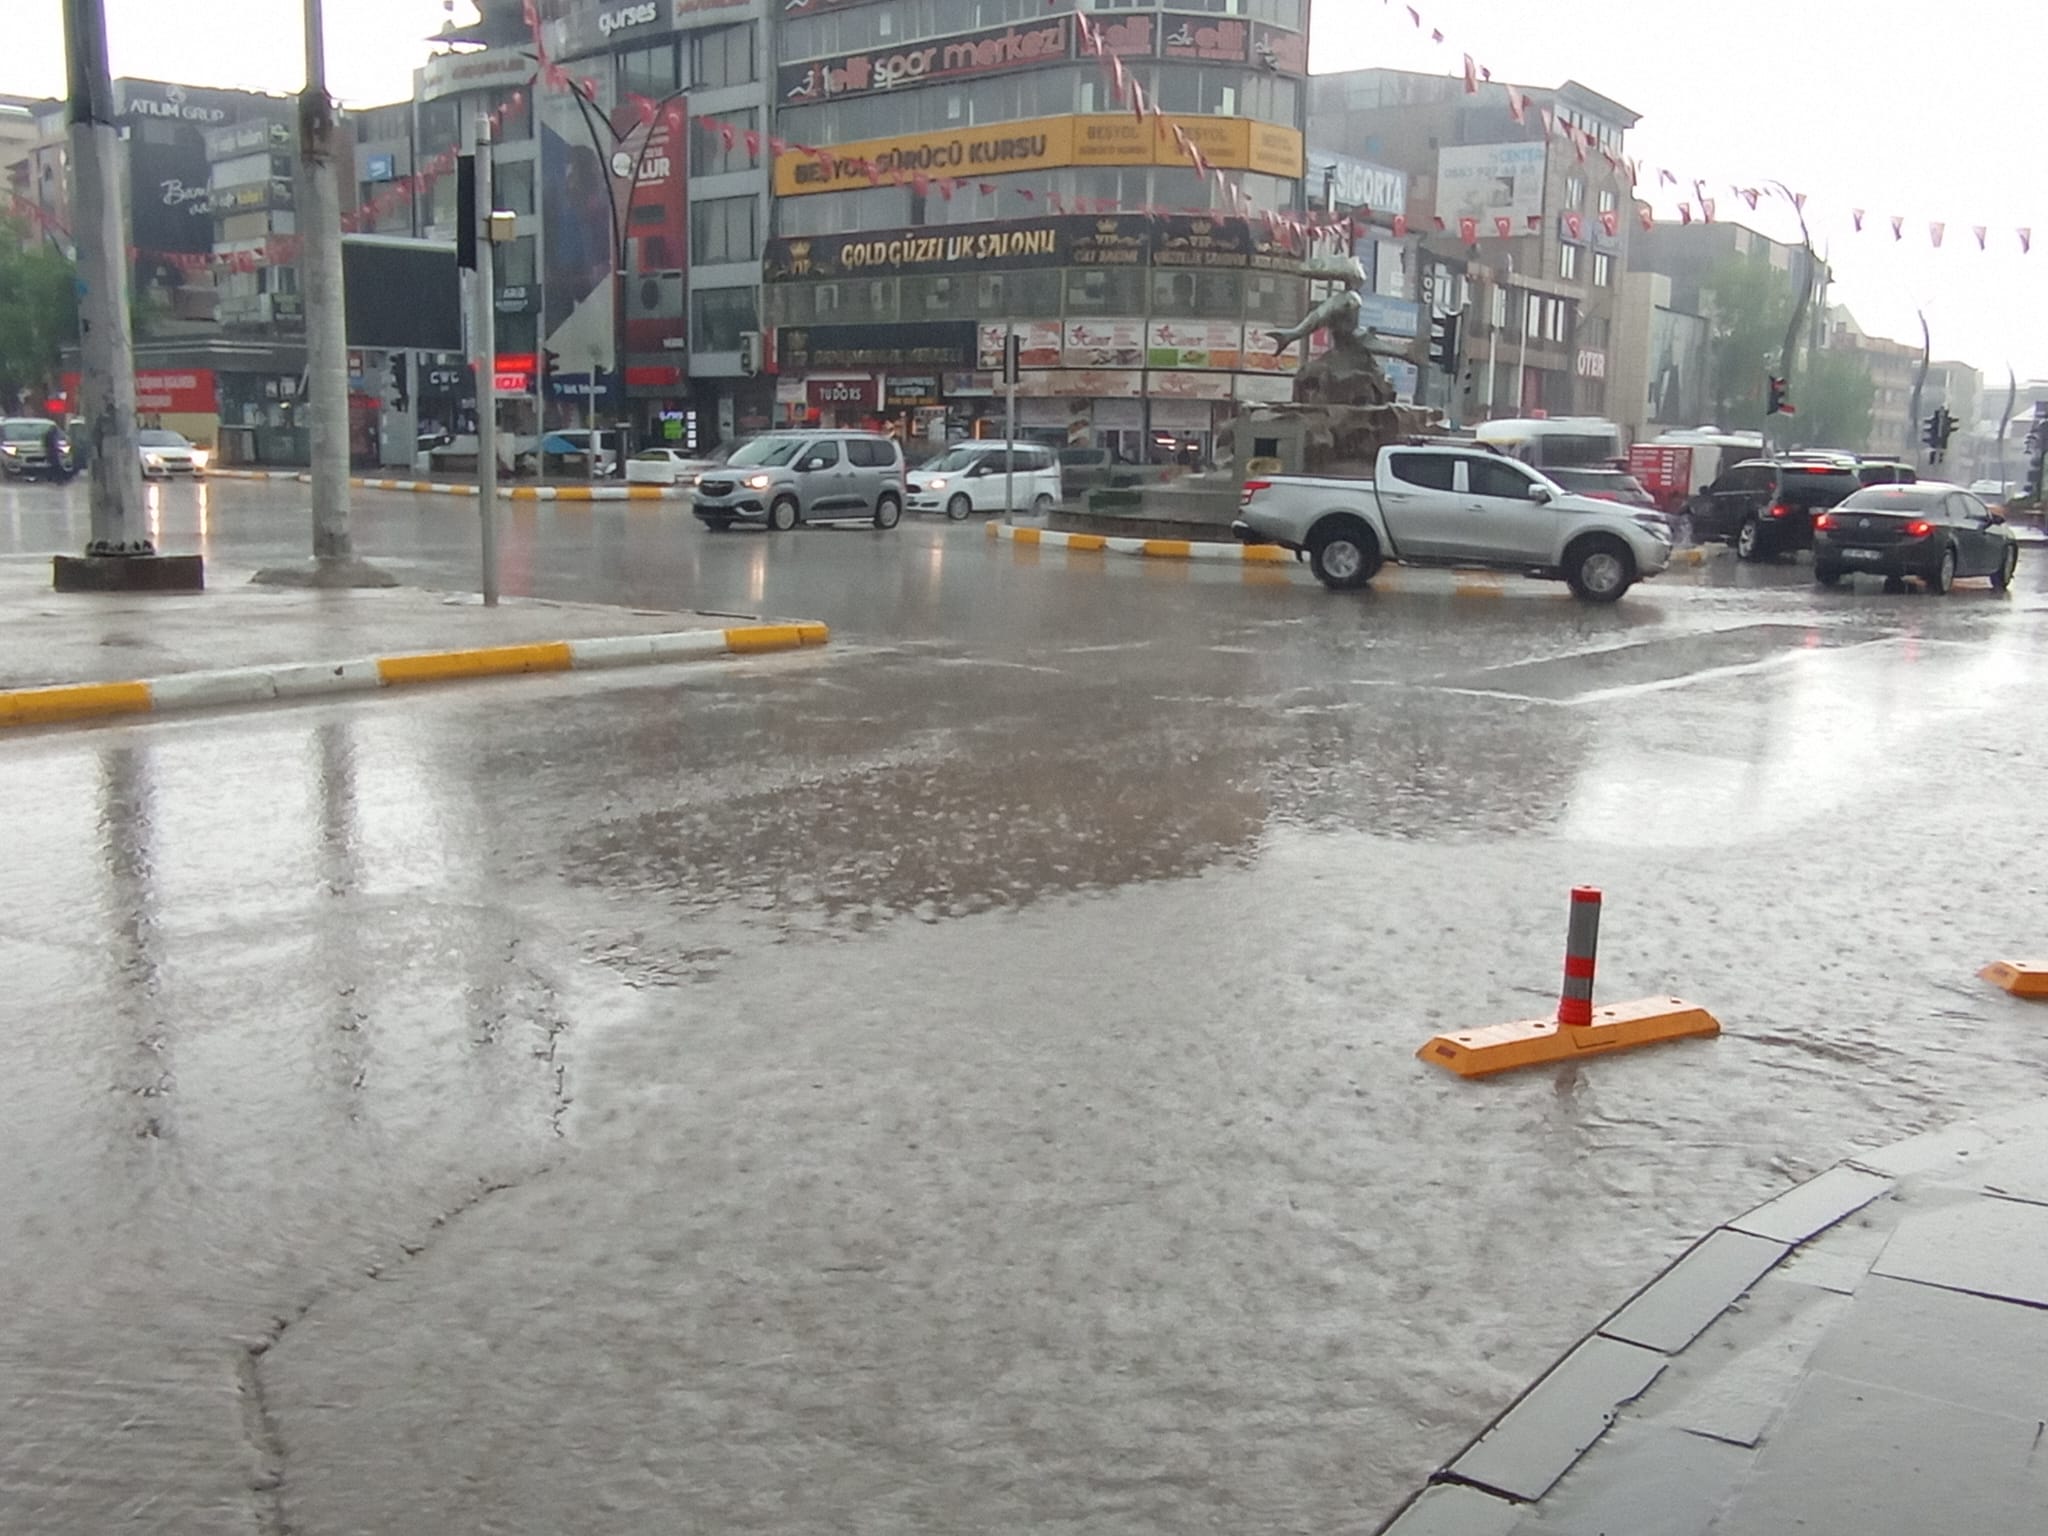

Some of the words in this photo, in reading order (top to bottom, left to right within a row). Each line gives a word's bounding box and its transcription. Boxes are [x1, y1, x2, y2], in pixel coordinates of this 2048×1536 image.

[874, 46, 937, 89] spor
[943, 18, 1066, 69] merkezi
[968, 134, 1047, 164] KURSU
